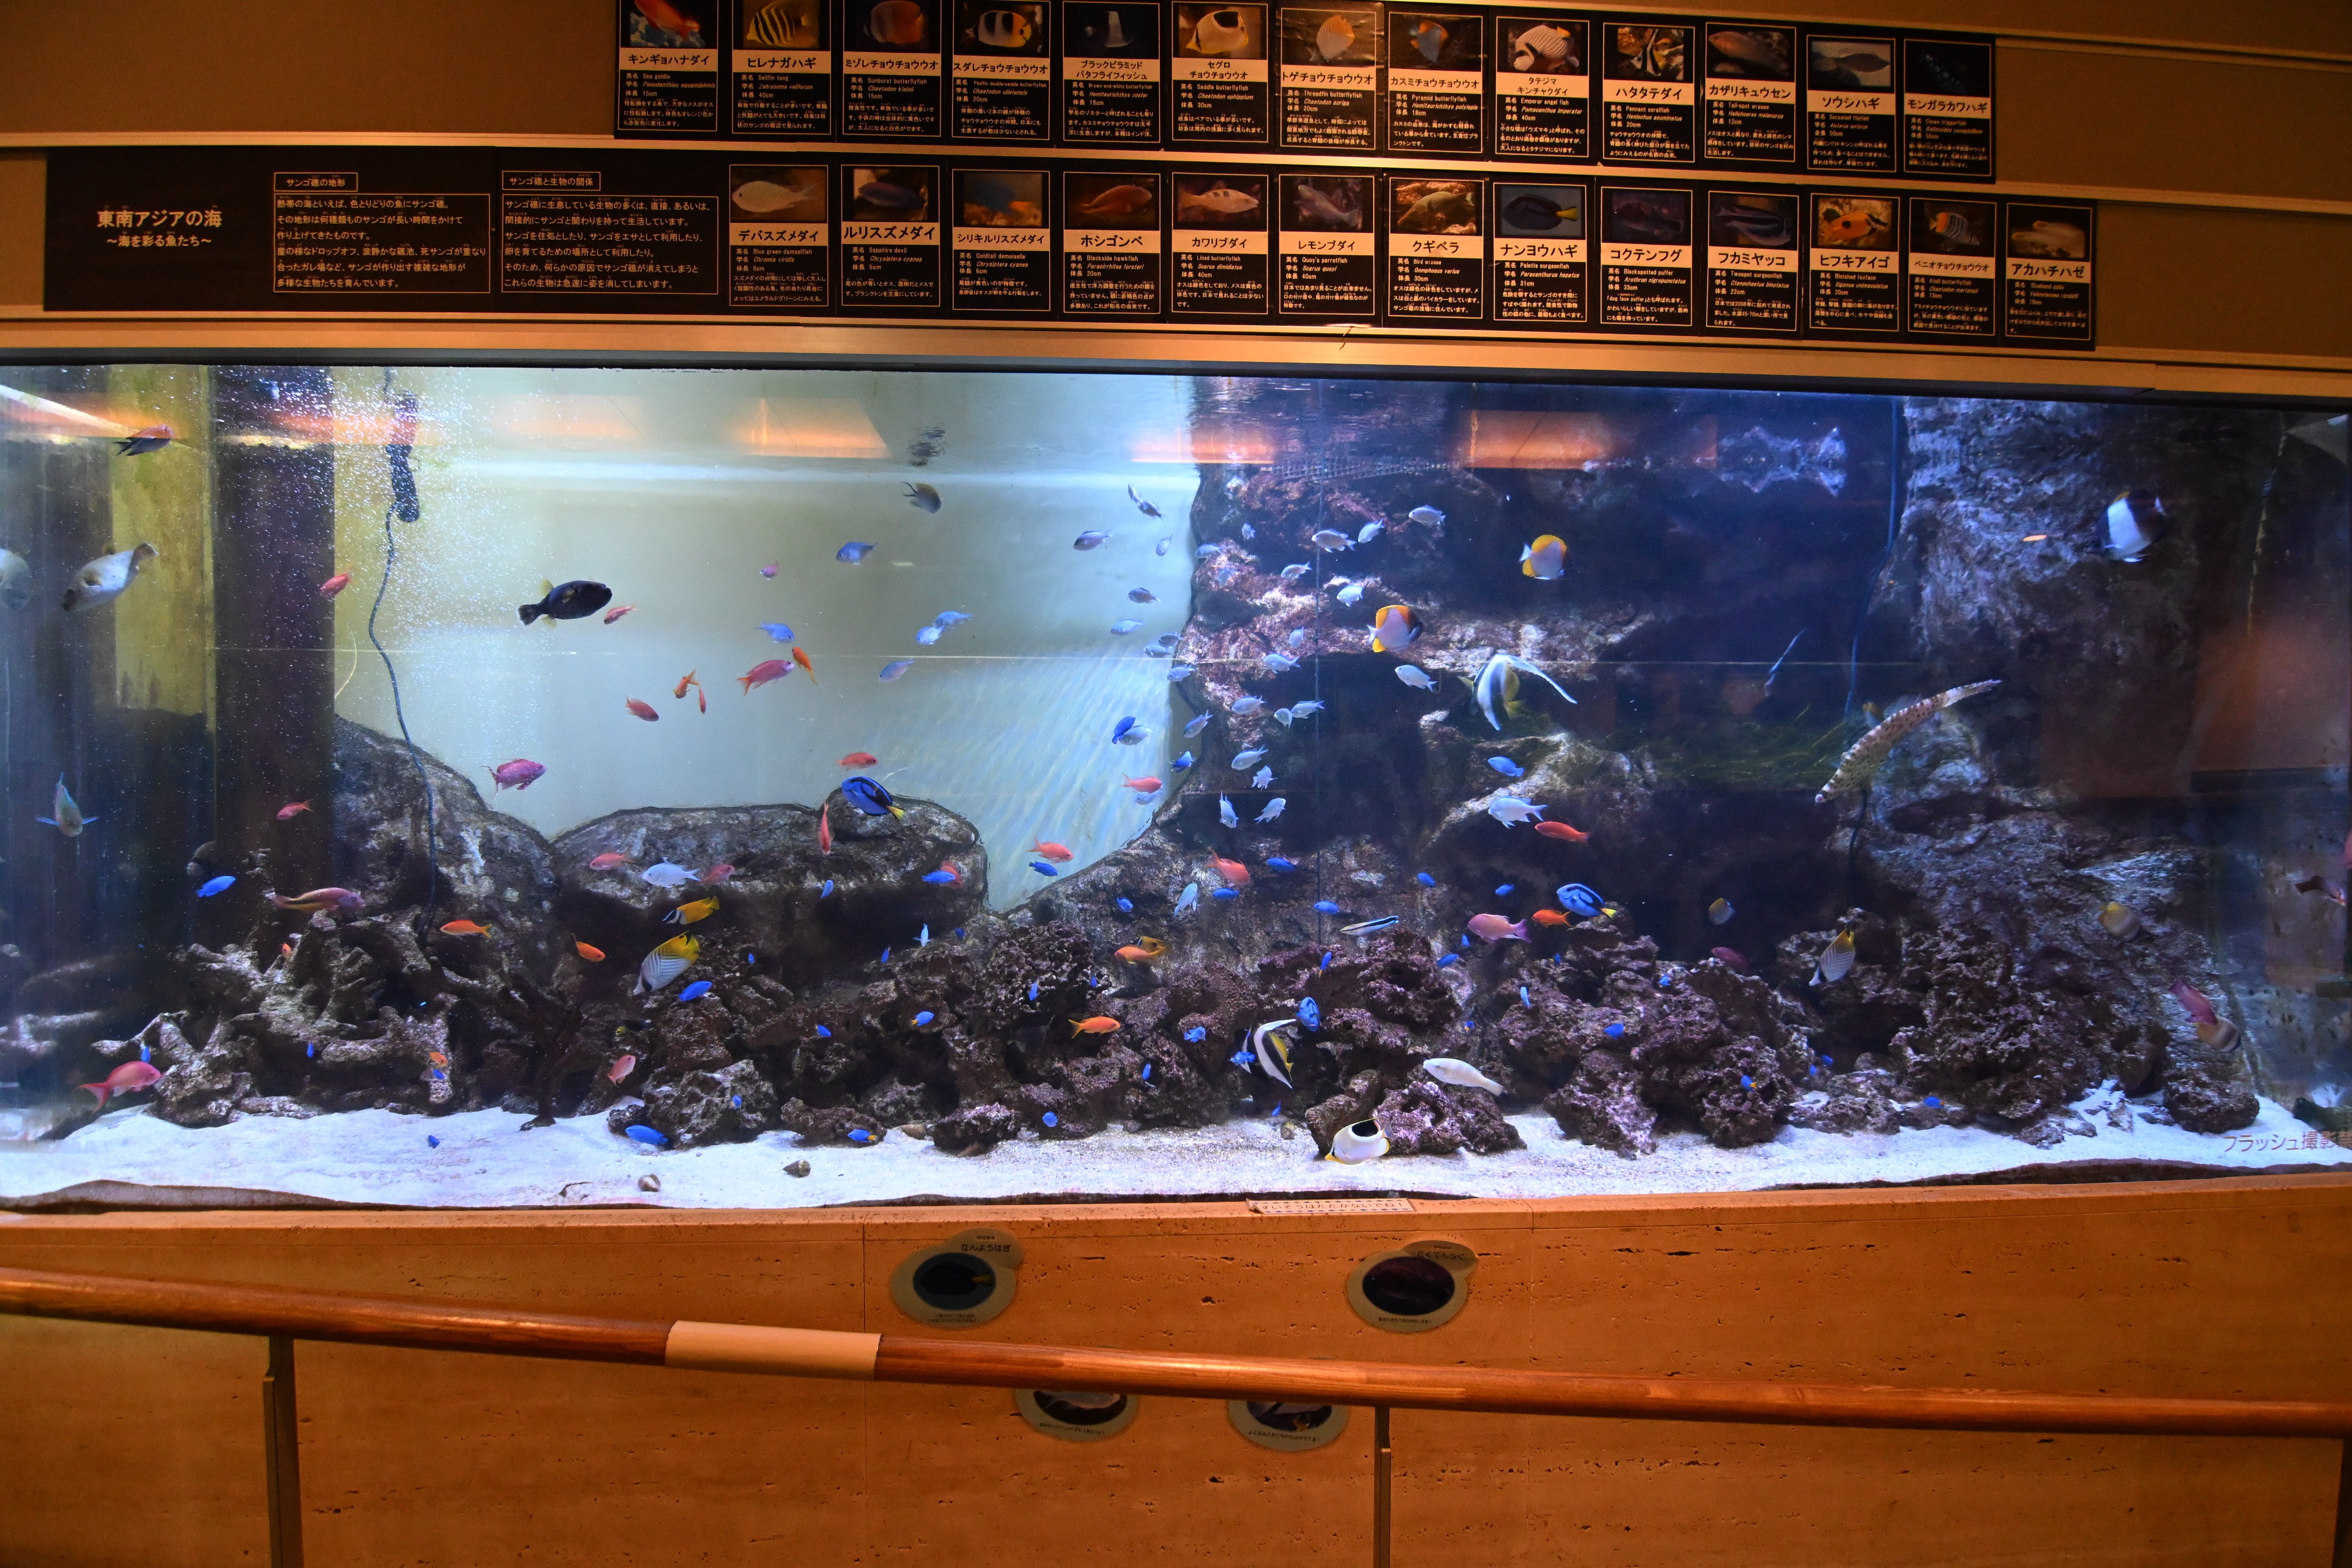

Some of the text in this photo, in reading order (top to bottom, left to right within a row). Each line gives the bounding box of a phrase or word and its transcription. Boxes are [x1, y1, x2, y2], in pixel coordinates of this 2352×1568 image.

[629, 54, 709, 65] キンギョハナダイ
[748, 57, 816, 69] ヒレナガハギ
[846, 59, 938, 70] ミゾレチョウチョウウオ
[1081, 60, 1142, 69] ブラックピラミッド
[953, 63, 1048, 74] スダレチョウチョウウオ
[1075, 71, 1147, 80] バタフライフィッシュ
[1189, 71, 1247, 81] チョウチョウウオ
[1283, 72, 1373, 84] トゲチョウチョウウオ
[1391, 77, 1479, 89] カスミチョウチョウウオ
[1516, 87, 1567, 96] キンチャクダイ
[1616, 87, 1682, 100] ハタタテダイ
[1710, 85, 1791, 98] カザリキュウセン
[1823, 96, 1880, 109] ソウシハギ
[1908, 100, 1987, 113] モンガラカワハギ
[286, 179, 345, 187] サンゴ礁の地形
[509, 177, 593, 186] サンゴ礁と生物の関係
[277, 200, 448, 208] 熱帯の海といえば、色とりどりの魚にサンゴ礁。
[506, 200, 709, 210] サンゴ礁に生息している生物の多くは、直接、あるいは、
[98, 210, 222, 227] 東南アジアの海
[278, 215, 463, 224] その地形は何種類ものサンゴが長い時間をかけて
[505, 215, 688, 226] 間接的にサンゴと関わりを持って生活しています。
[277, 231, 369, 240] 作り上げてきたものです。
[505, 232, 702, 241] サンゴを住処としたり、サンゴをエサとして利用したり、
[739, 230, 818, 242] デバスズメダイ
[844, 226, 935, 240] ルリスズメダイ
[958, 234, 1044, 244] シリキルリスズメダイ
[1081, 235, 1143, 247] ホシゴンベ
[1192, 237, 1247, 248] カワリブダイ
[1299, 240, 1355, 250] レモンブダイ
[1413, 241, 1459, 253] クギベラ
[278, 247, 485, 256] 崖の様なドロップオフ、波静かな礁池、死サンゴが重なり
[505, 248, 653, 257] 卵を育てるための場所として利用したり。
[1501, 244, 1577, 258] ナンヨウハギ
[1611, 248, 1682, 262] コクテンフグ
[1718, 252, 1785, 266] フカミヤッコ
[1821, 255, 1890, 268] ヒフキアイゴ
[277, 263, 465, 271] 合ったガレ場など、サンゴが作り出す複雑な地形が
[505, 264, 698, 272] そのため、何らかの原因でサンゴ礁が消えてしまうと
[2010, 264, 2085, 279] アカハチハゼ
[278, 279, 398, 287] 多様な生物たちを育んでいます。
[505, 278, 672, 288] これらの生物は急速に姿を消してしまいます。
[961, 1244, 1011, 1252] なんようはぎ
